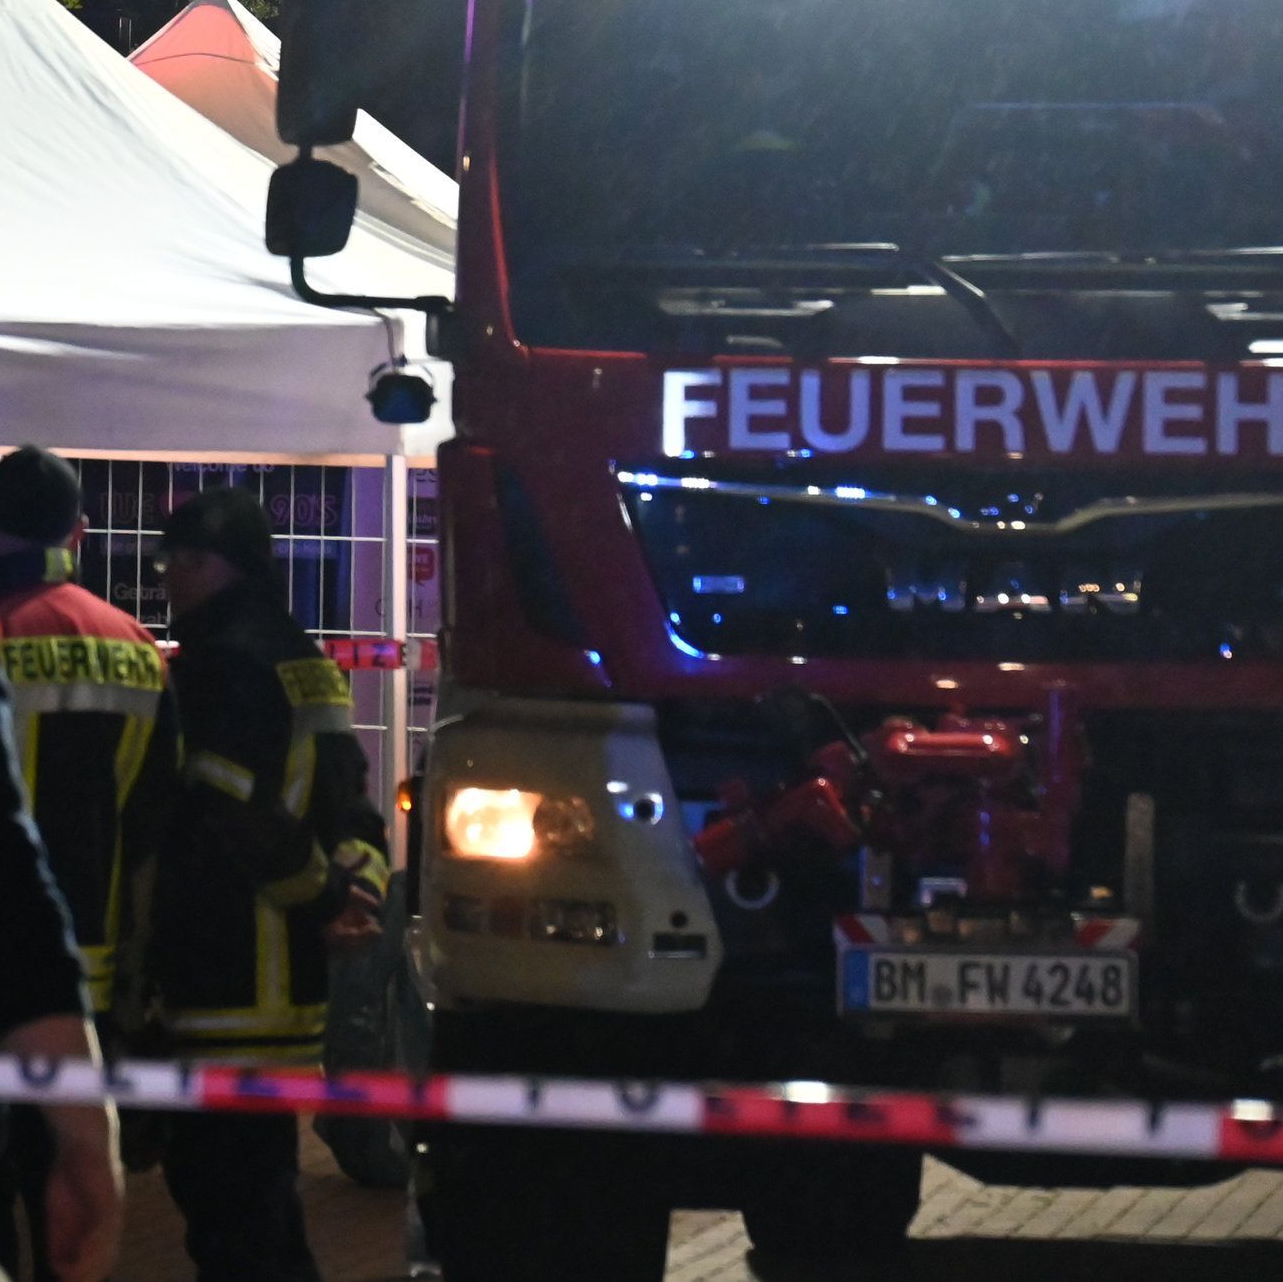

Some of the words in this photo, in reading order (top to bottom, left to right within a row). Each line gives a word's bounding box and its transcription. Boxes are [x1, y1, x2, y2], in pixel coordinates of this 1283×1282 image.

[874, 957, 926, 1003] BM
[957, 960, 1010, 1005] FW
[1021, 962, 1123, 1007] 4248
